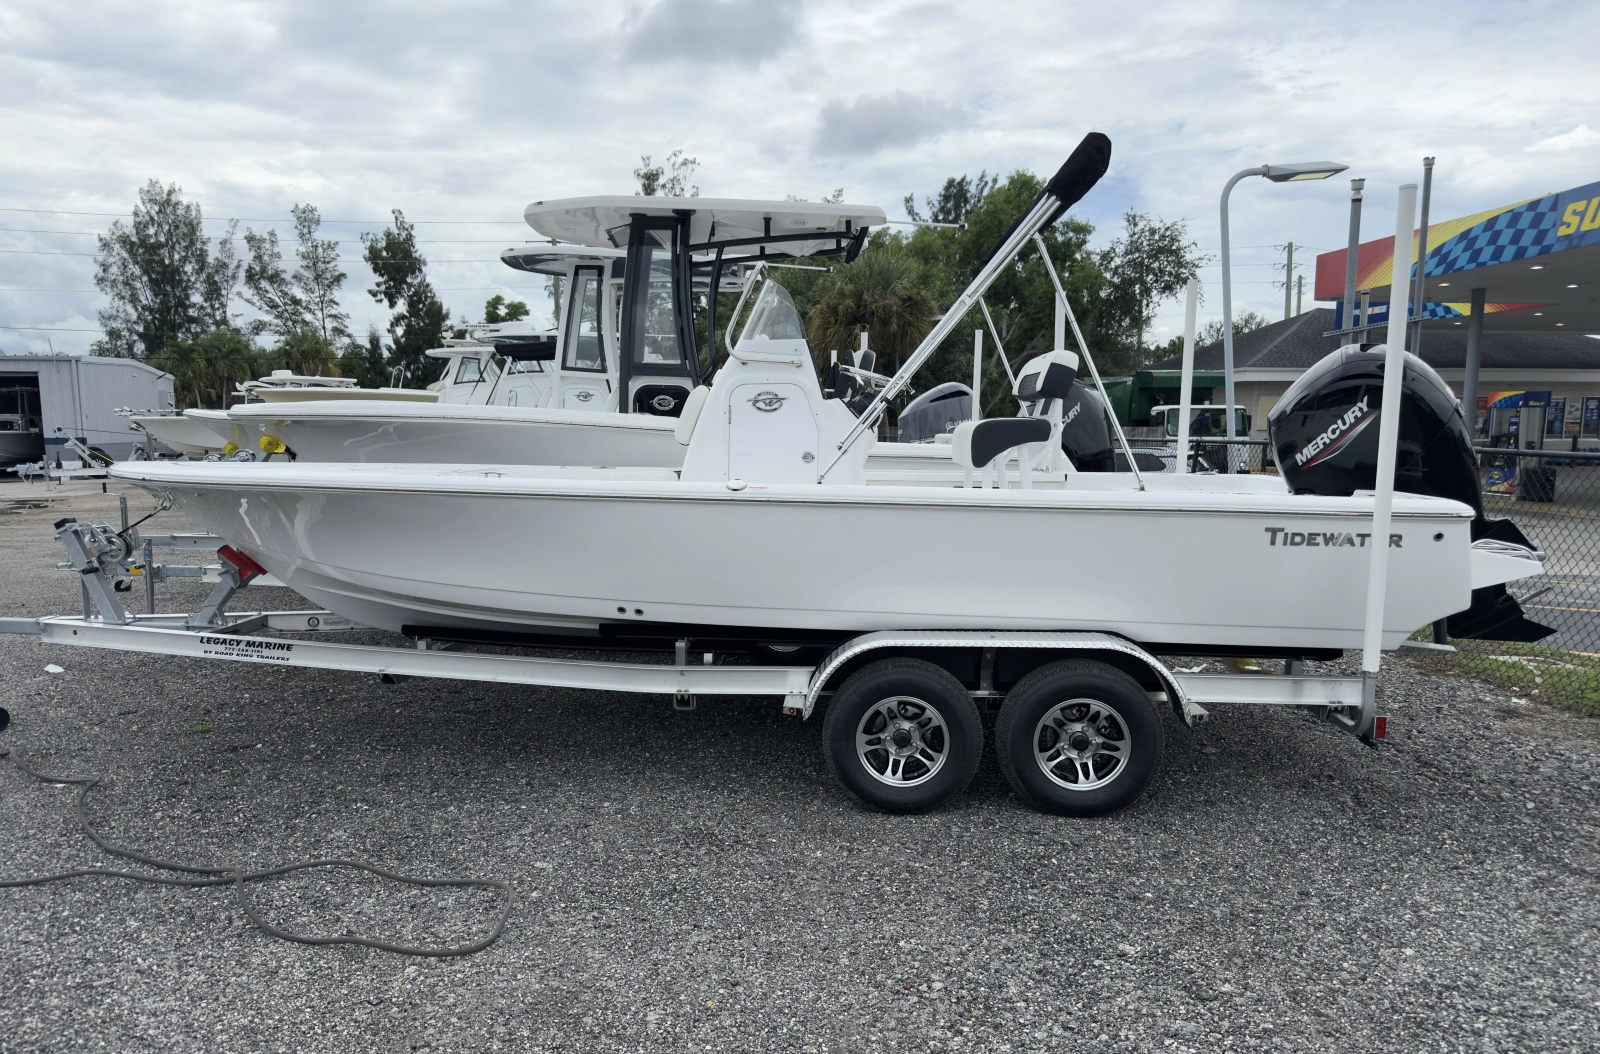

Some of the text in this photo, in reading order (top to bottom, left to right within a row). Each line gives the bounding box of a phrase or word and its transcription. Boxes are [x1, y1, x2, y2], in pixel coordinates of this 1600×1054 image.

[1295, 395, 1368, 466] MERCURY
[1264, 527, 1403, 548] TIDEWATR
[200, 637, 294, 651] LEGACY MARINE
[256, 654, 290, 662] TRAILERS
